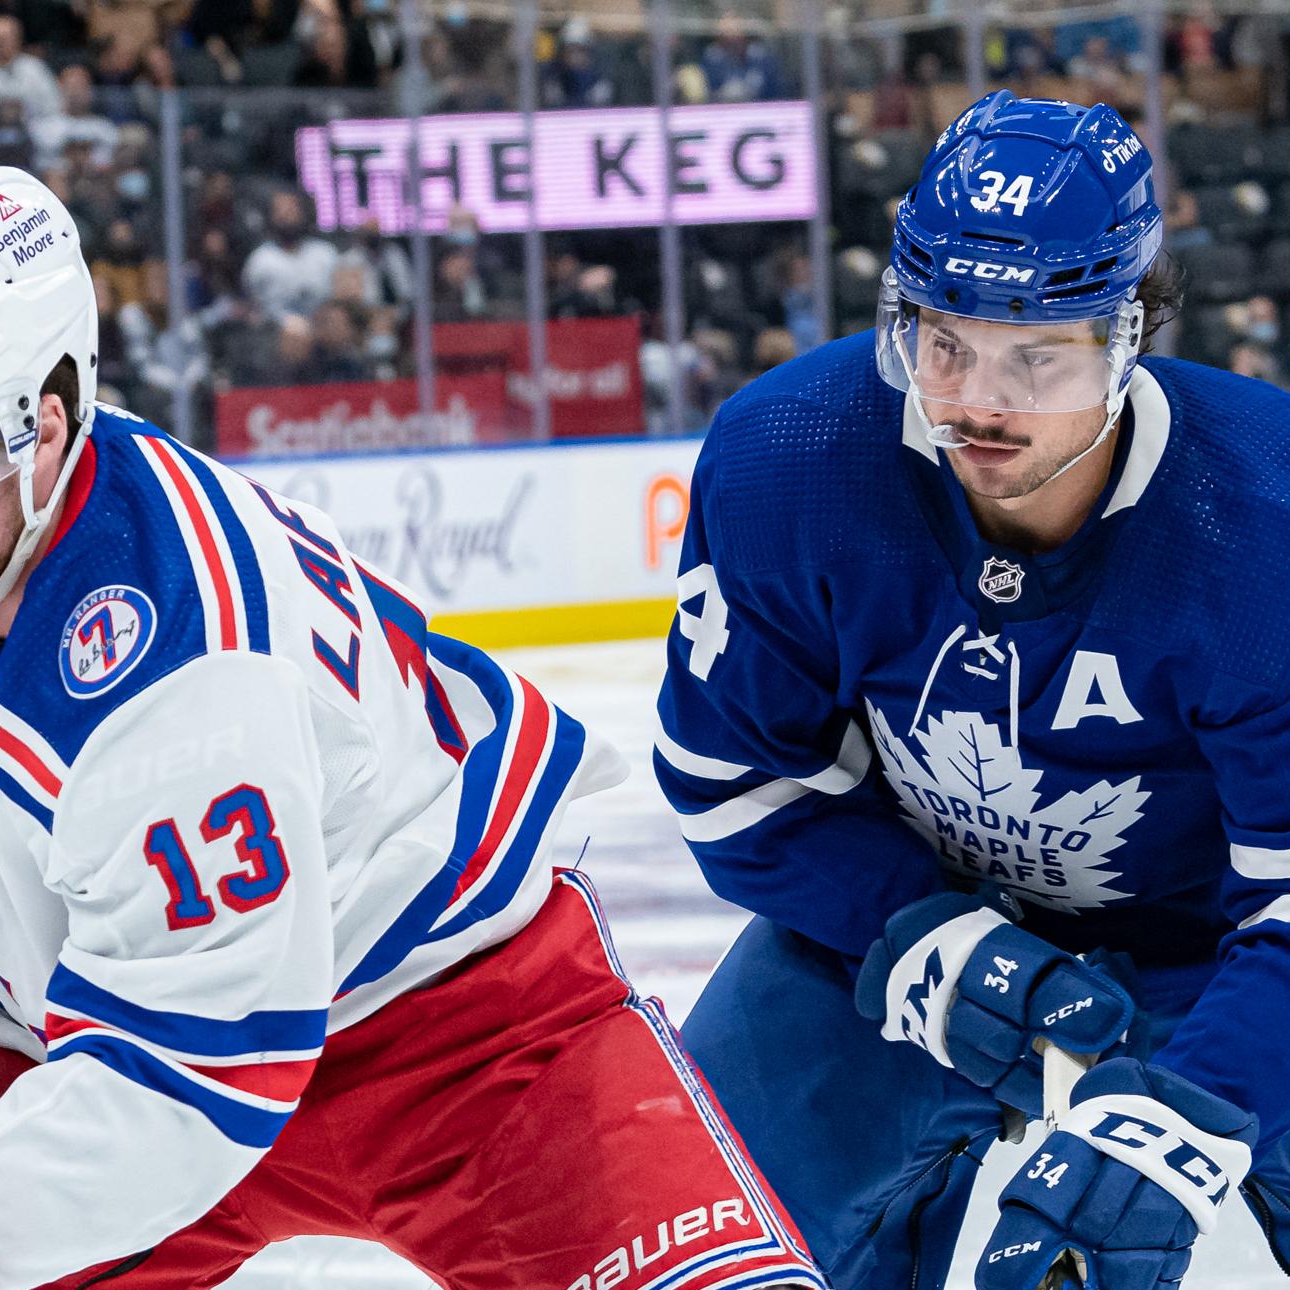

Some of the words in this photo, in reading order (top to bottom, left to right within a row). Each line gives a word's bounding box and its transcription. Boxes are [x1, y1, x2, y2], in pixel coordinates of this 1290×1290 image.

[333, 140, 531, 208] THE
[593, 130, 787, 198] KEG
[970, 170, 1034, 217] 34
[12, 231, 54, 267] Moore
[945, 257, 1036, 283] CCM
[395, 458, 537, 600] Royal
[75, 589, 125, 621] RANGER
[989, 574, 1015, 591] NHL
[78, 605, 117, 672] 7
[1050, 650, 1144, 729] A
[901, 779, 1092, 853] TORONTO
[143, 783, 290, 932] 13
[934, 814, 1062, 878] MAPLE
[939, 836, 1067, 887] LEAFS
[984, 956, 1019, 994] 34
[1043, 996, 1093, 1026] CCM
[1028, 1152, 1069, 1189] 34
[989, 1240, 1041, 1264] CCM
